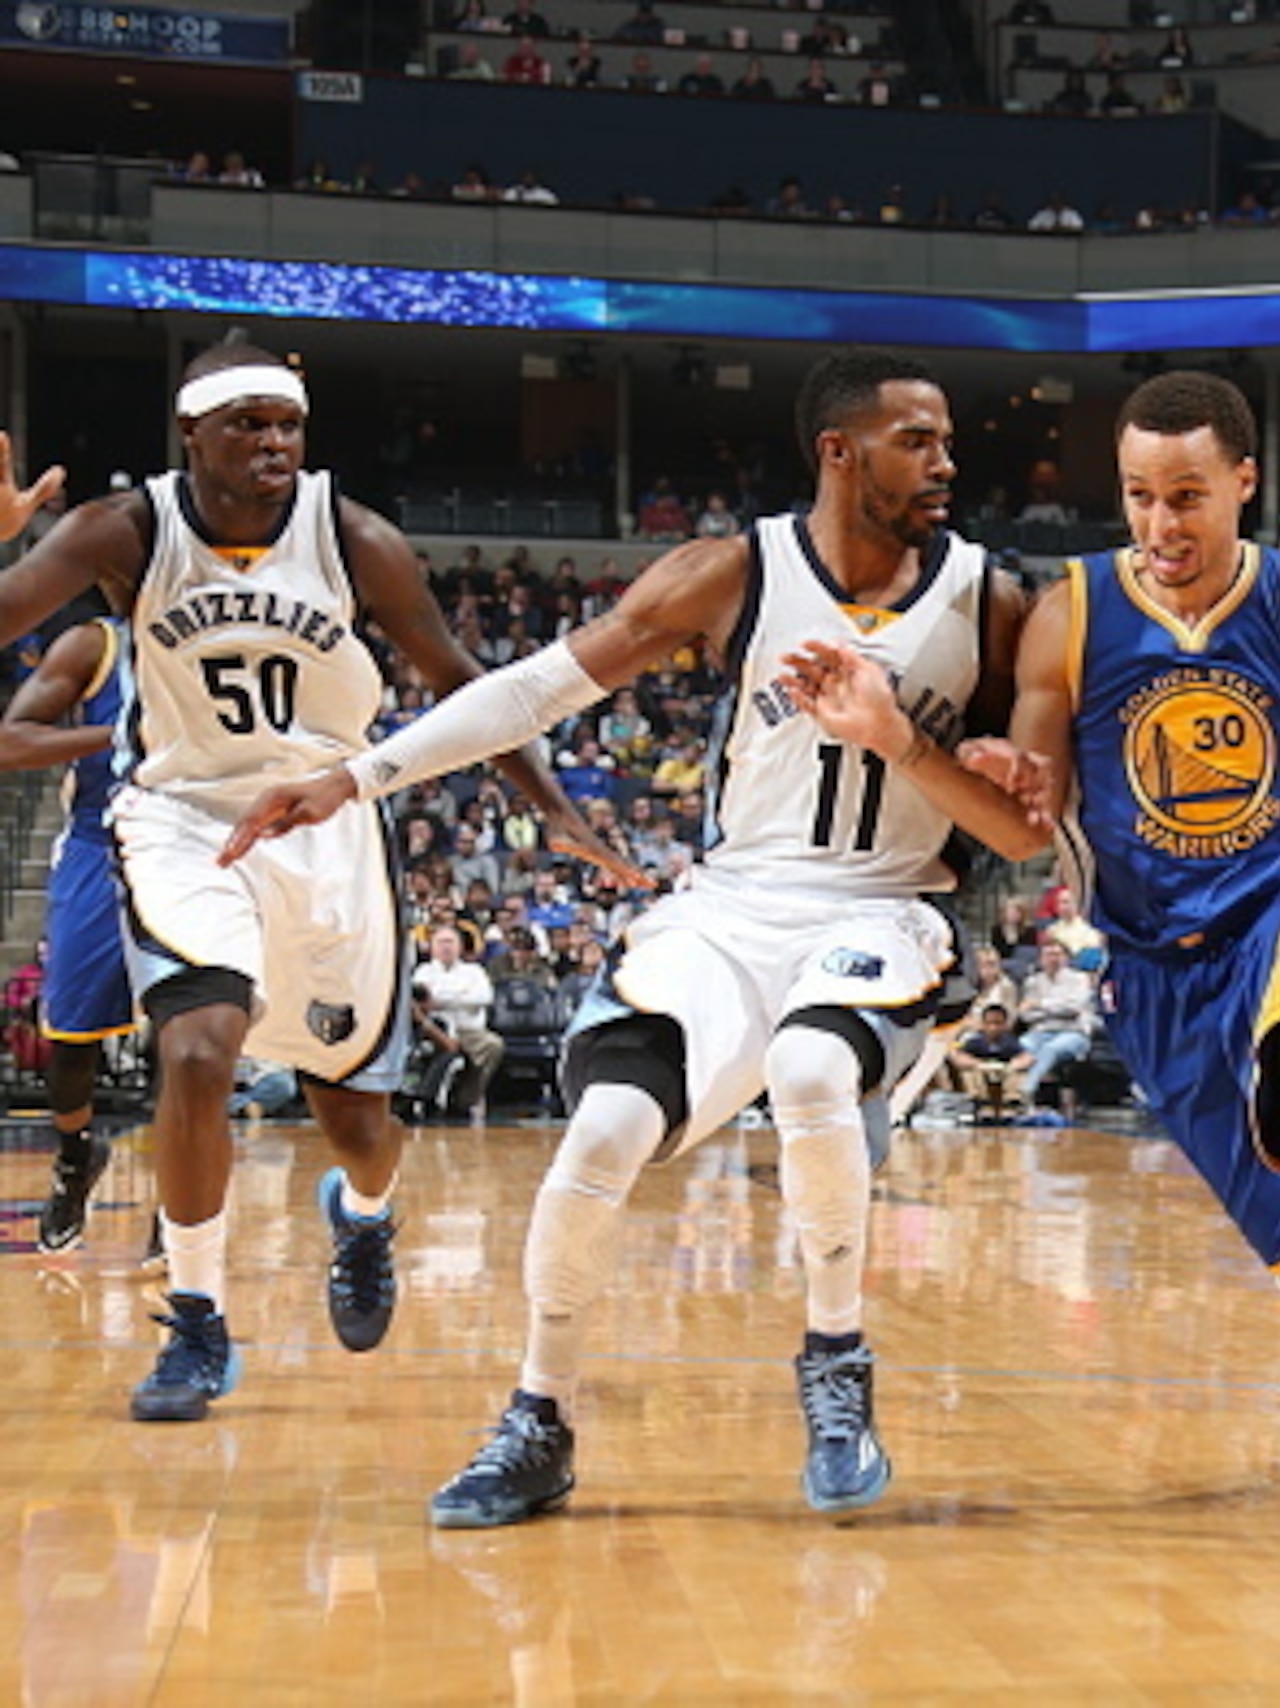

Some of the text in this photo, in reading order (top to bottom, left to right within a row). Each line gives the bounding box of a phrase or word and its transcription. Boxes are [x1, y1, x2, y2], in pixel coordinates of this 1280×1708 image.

[148, 591, 345, 652] GRIZZLIES
[200, 654, 298, 734] 50
[1117, 667, 1274, 724] GOLDEN STATE
[1193, 713, 1246, 751] 30
[811, 743, 887, 851] 11
